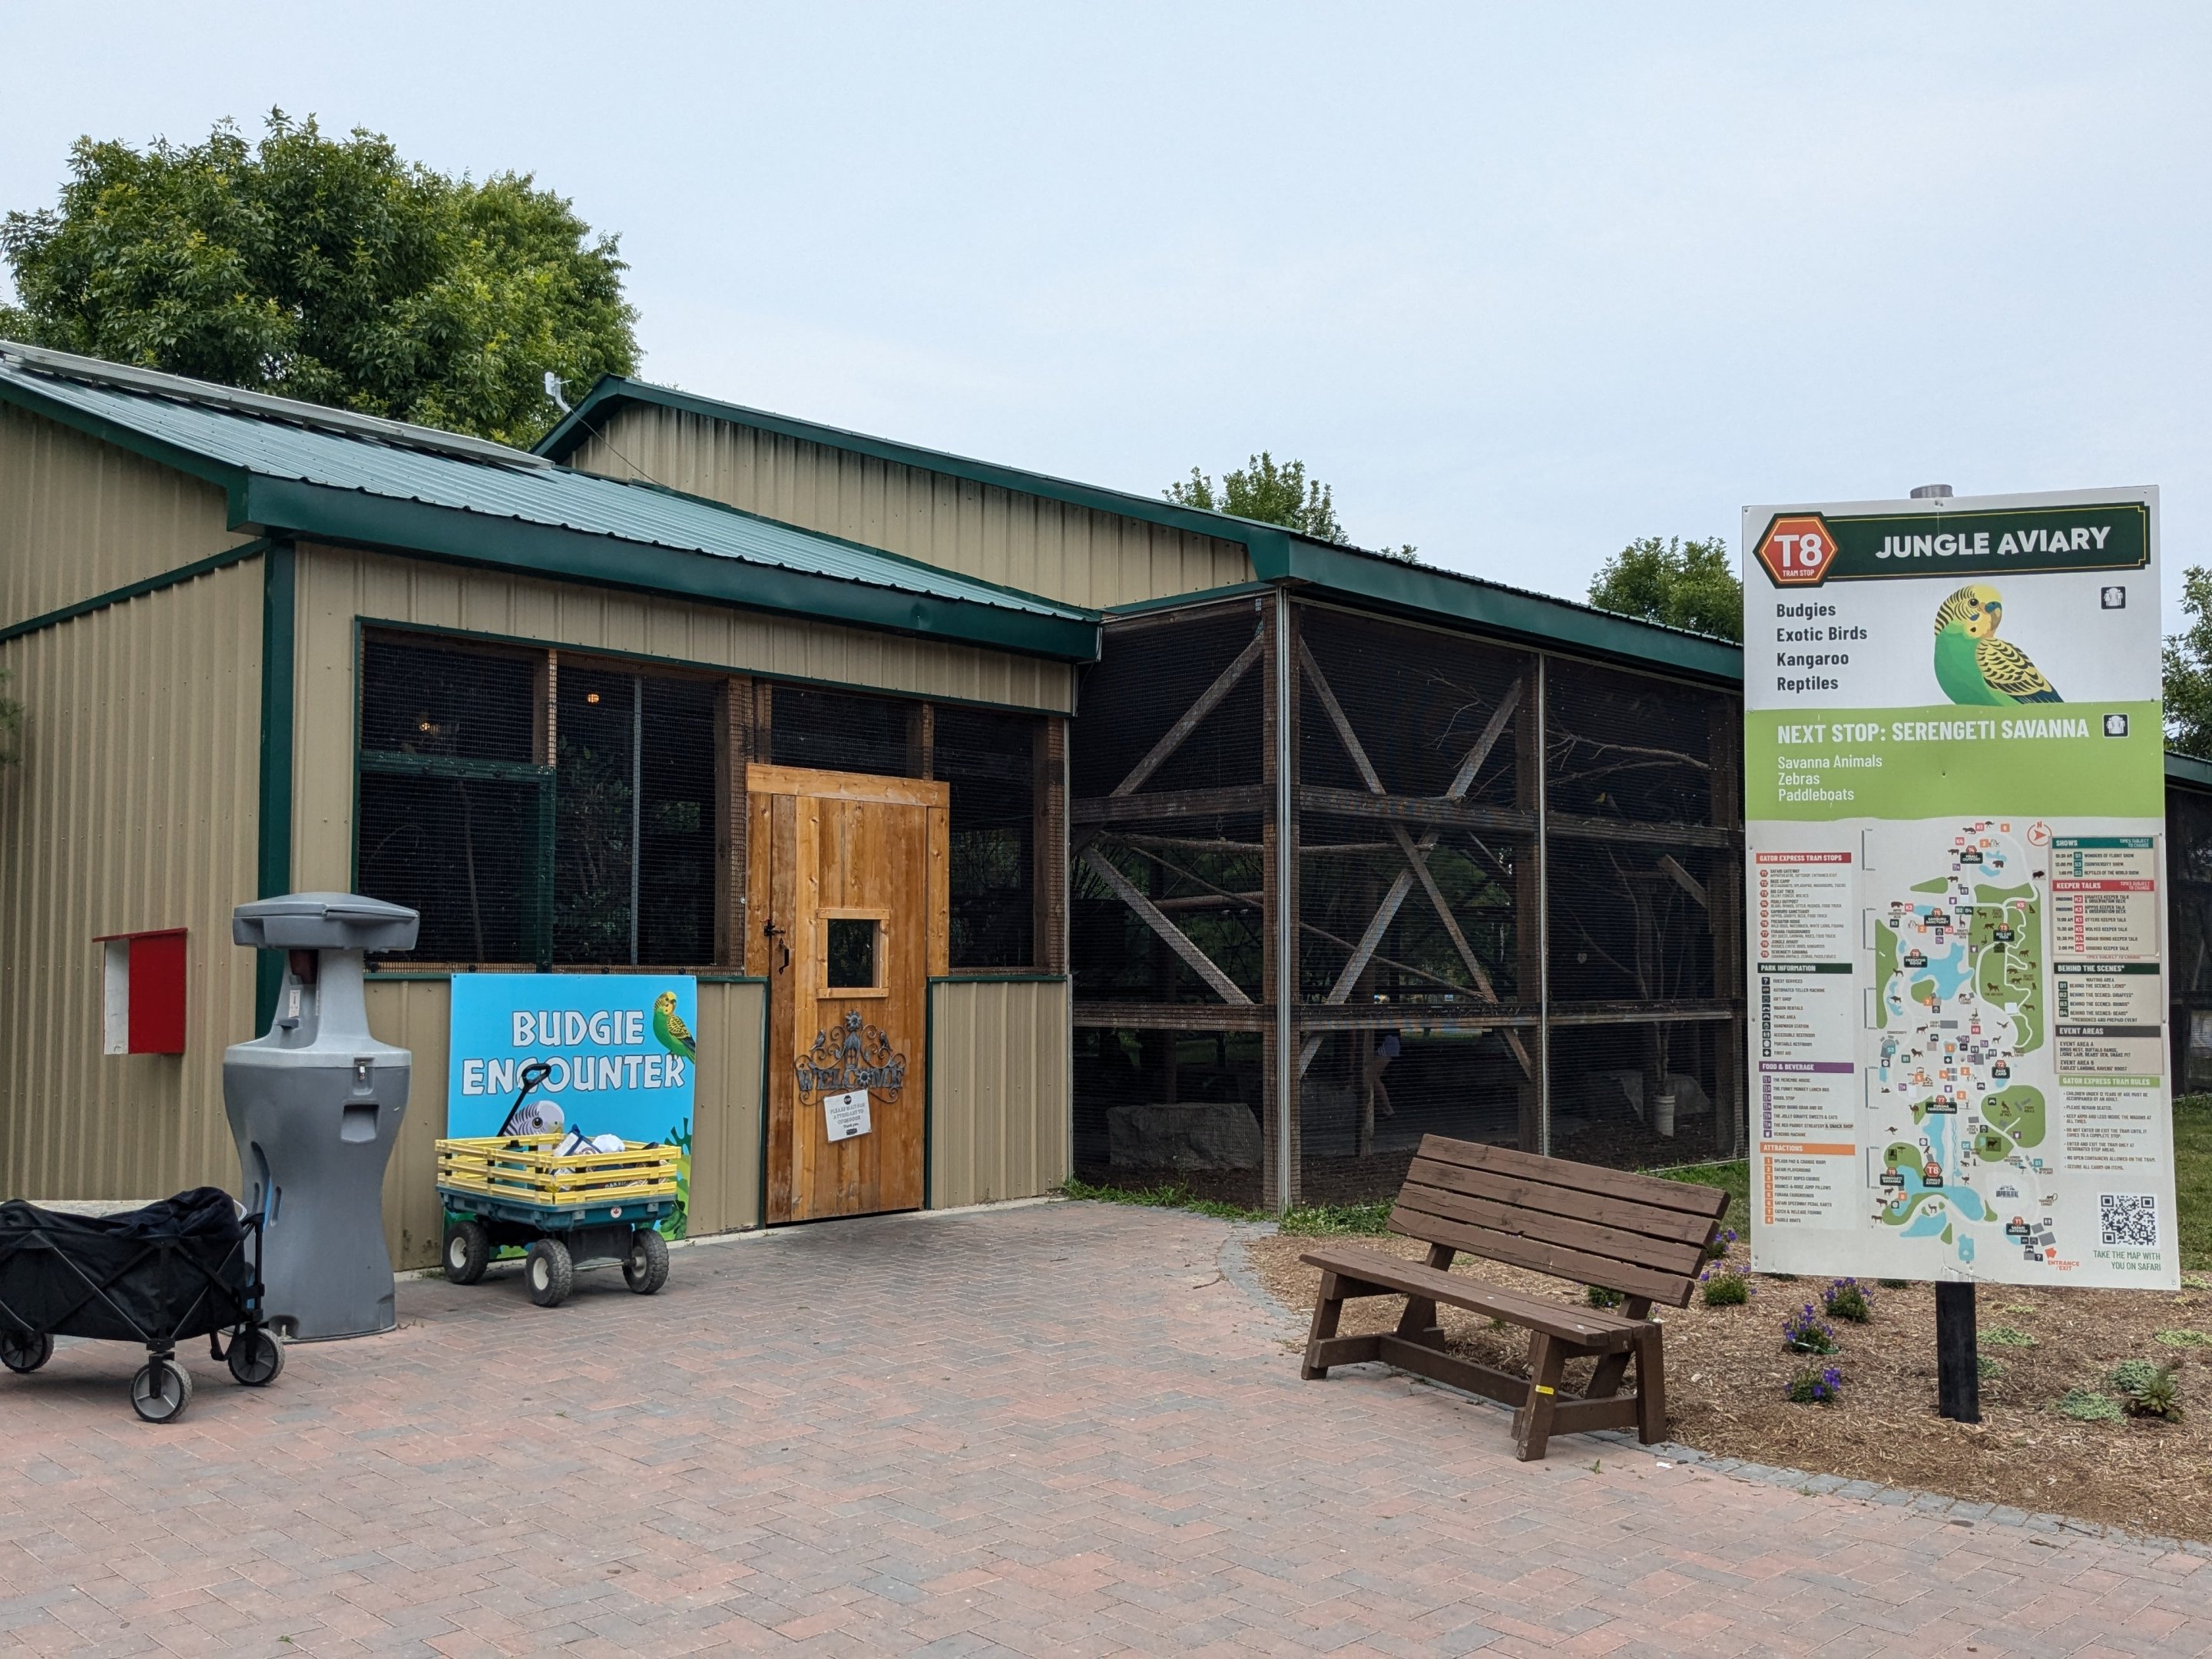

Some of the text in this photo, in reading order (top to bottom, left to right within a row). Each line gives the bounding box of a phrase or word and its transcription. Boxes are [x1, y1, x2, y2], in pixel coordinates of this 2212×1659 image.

[1773, 532, 1823, 568] T8
[1876, 526, 2111, 558] JUNGLE AVIARY
[1782, 568, 1814, 577] TRAM STOP
[1777, 602, 1836, 621] Budgies
[1777, 625, 1868, 642] Exotic Birds
[1777, 651, 1849, 671] Kangaroo
[1777, 676, 1839, 694] Reptiles
[1777, 718, 2090, 743] NEXT STOP: SERENGETI SAVANNA
[1778, 753, 1883, 770] Savanna Animals
[1778, 771, 1820, 786] Zebras
[1778, 787, 1854, 802] Paddleboats
[512, 1010, 645, 1047] BUDGIE
[462, 1055, 686, 1097] ENCOUNTER
[2093, 1250, 2111, 1259] TAKE
[2142, 1252, 2161, 1260] WITH
[2111, 1261, 2161, 1271] YOU ON SAFARI
